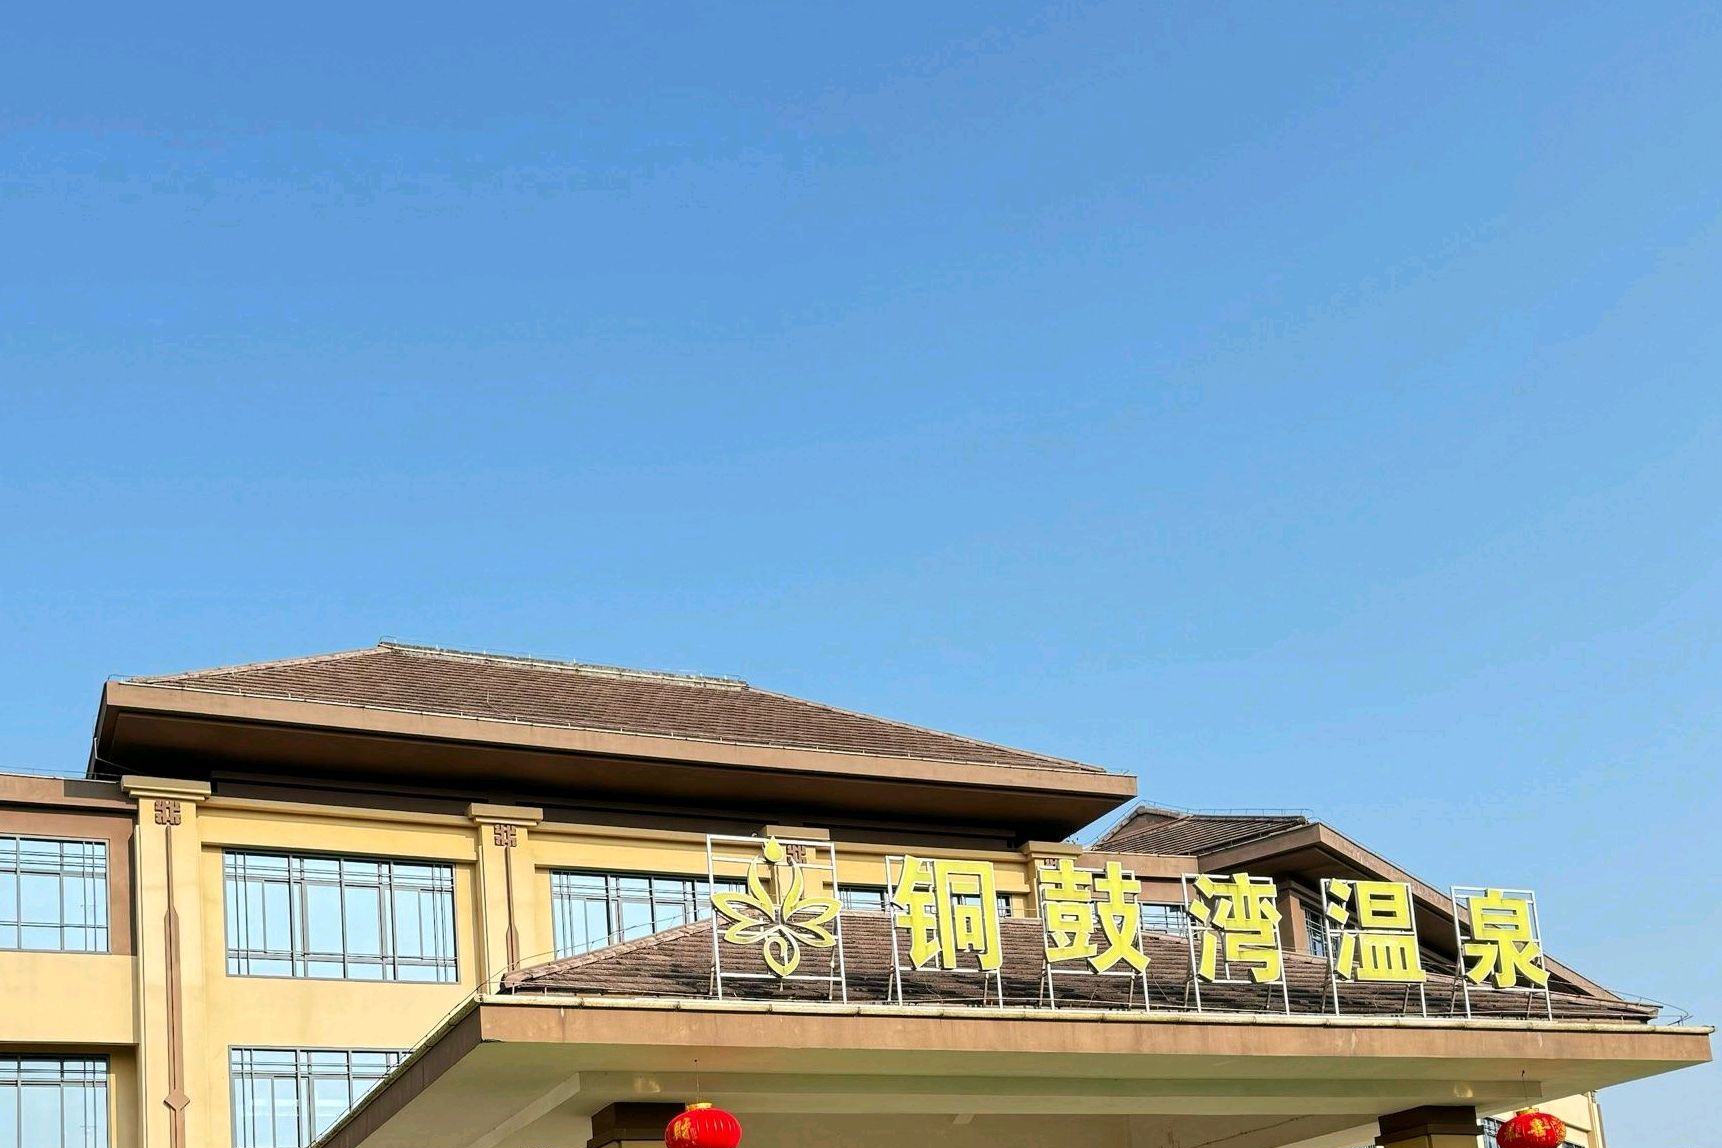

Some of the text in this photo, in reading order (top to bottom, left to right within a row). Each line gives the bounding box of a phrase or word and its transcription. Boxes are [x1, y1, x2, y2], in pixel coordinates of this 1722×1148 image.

[892, 854, 1550, 988] 铜鼓湾温泉
